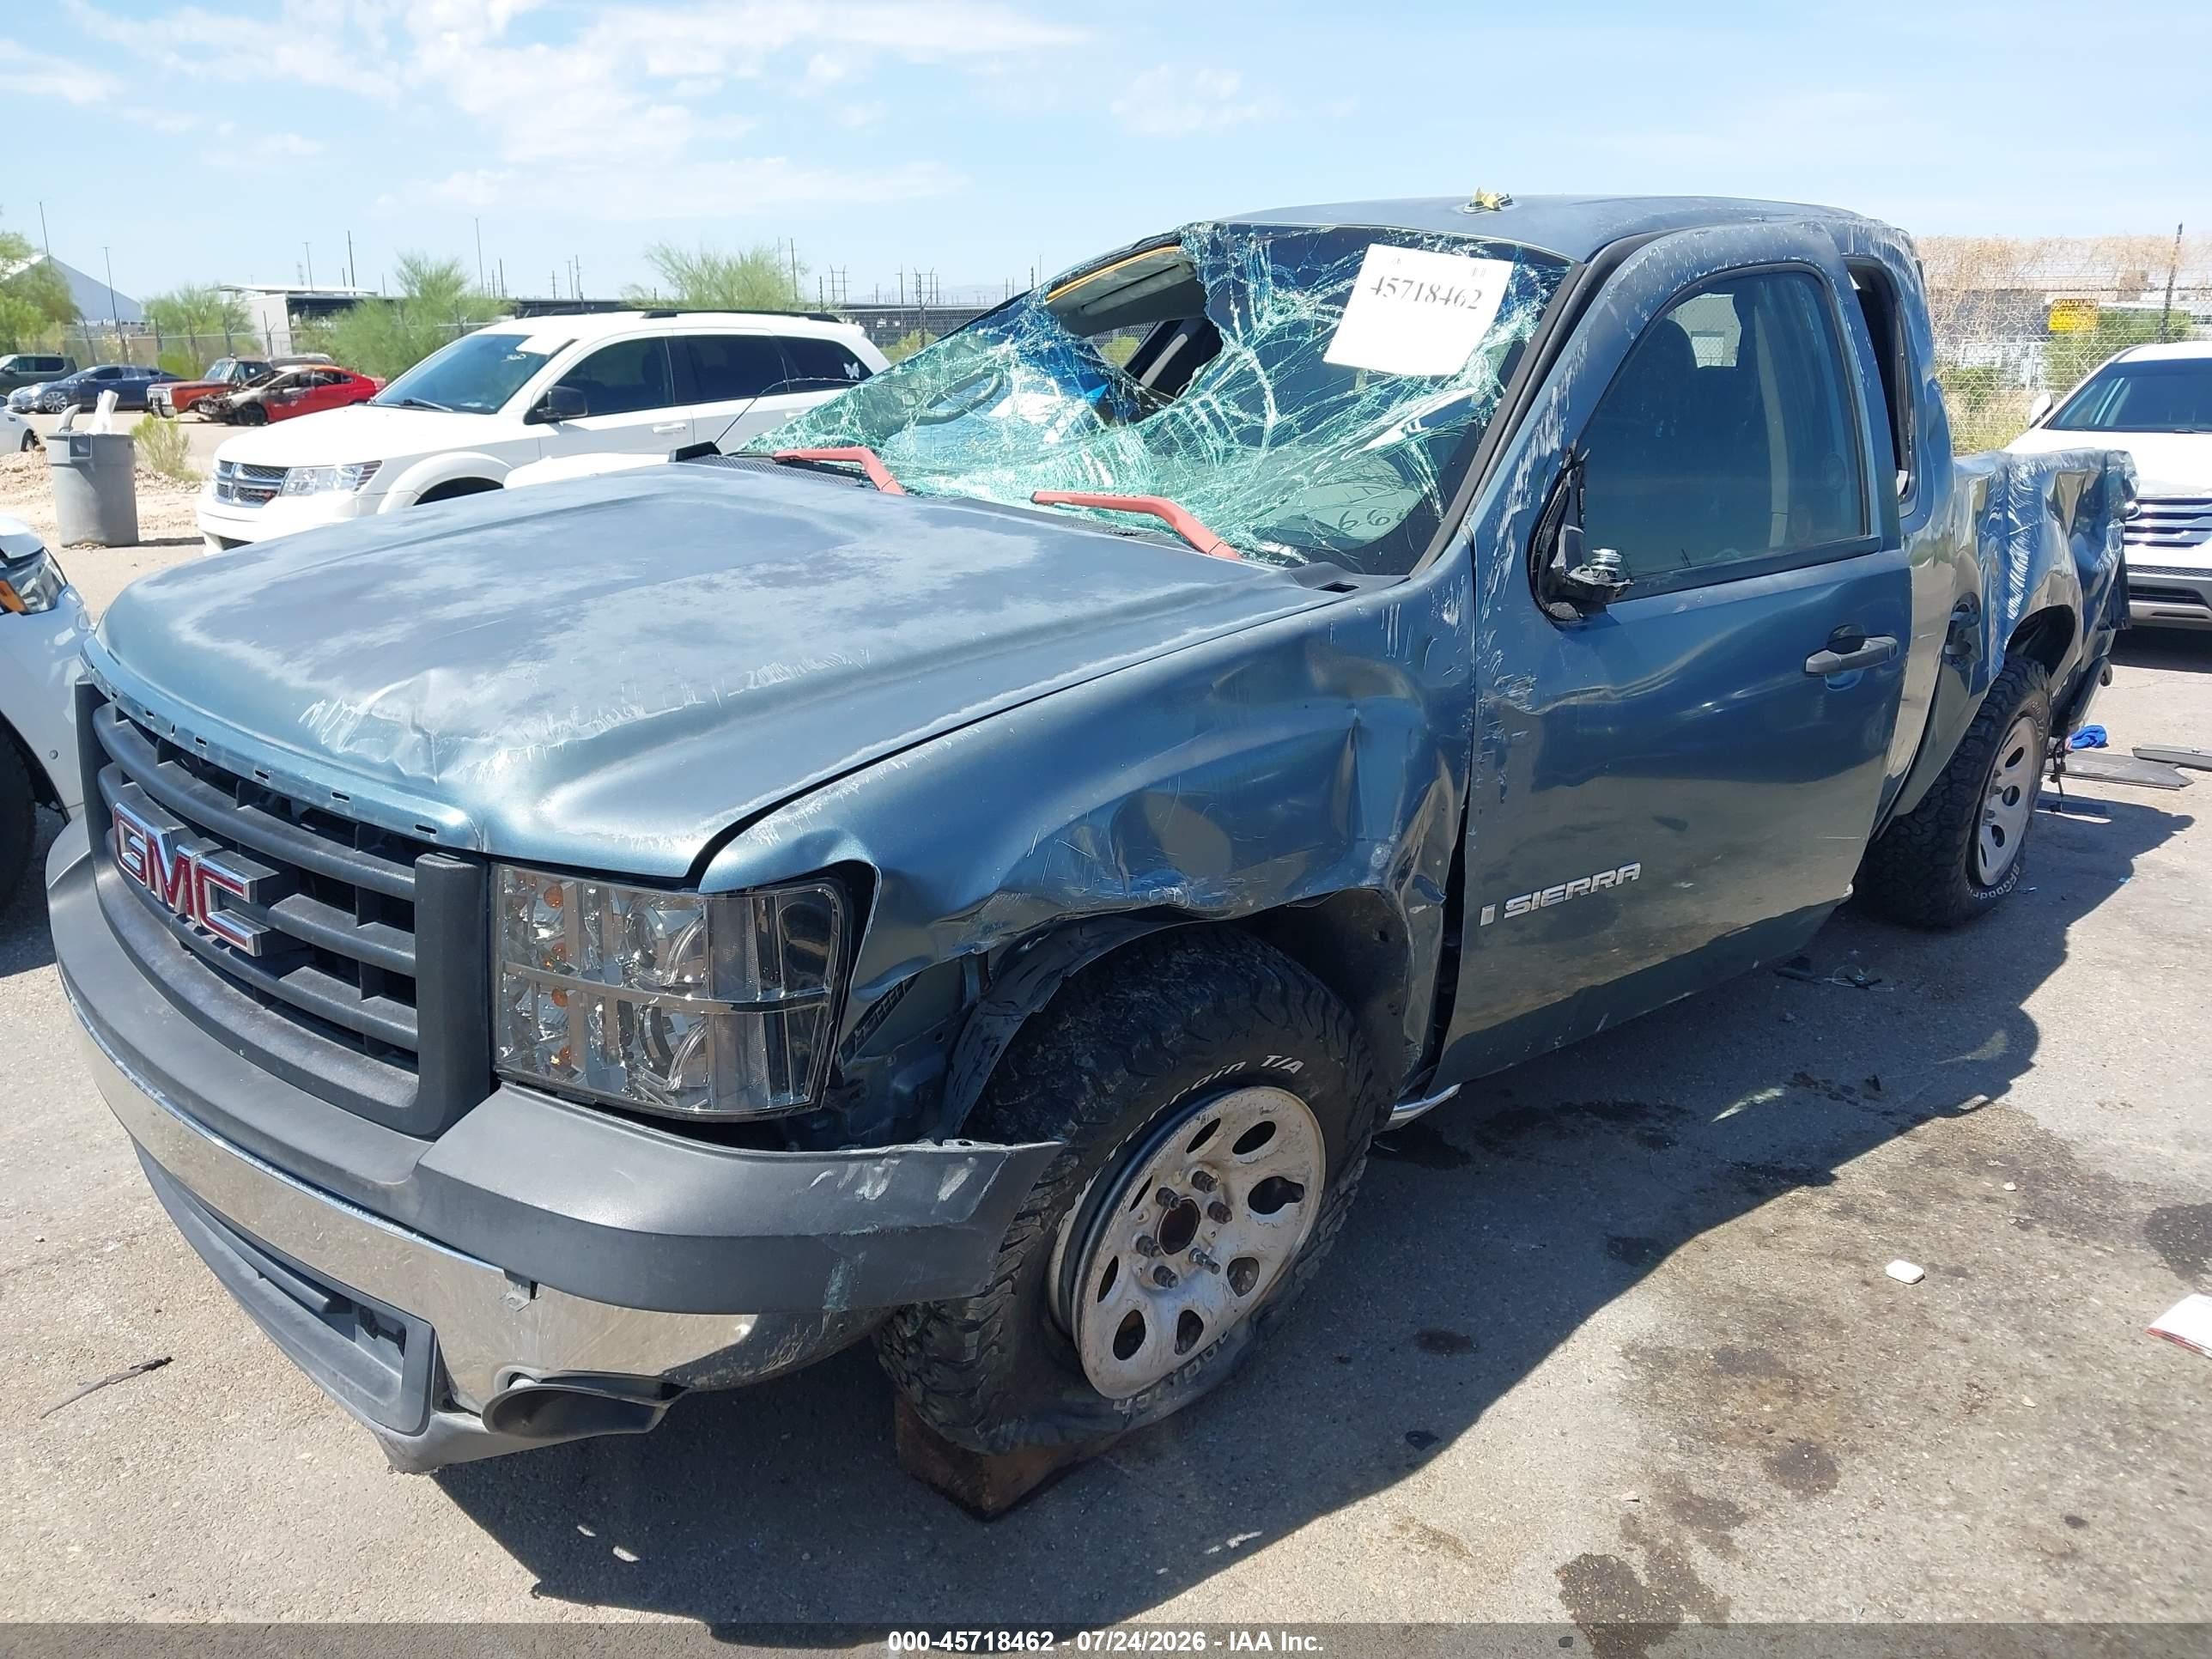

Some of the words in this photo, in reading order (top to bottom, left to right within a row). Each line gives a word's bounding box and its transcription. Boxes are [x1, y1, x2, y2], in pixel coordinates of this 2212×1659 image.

[1370, 276, 1483, 310] 45718462
[112, 802, 262, 957] GMC
[1504, 862, 1641, 919] SIERRA
[1260, 1054, 1305, 1074] T/A
